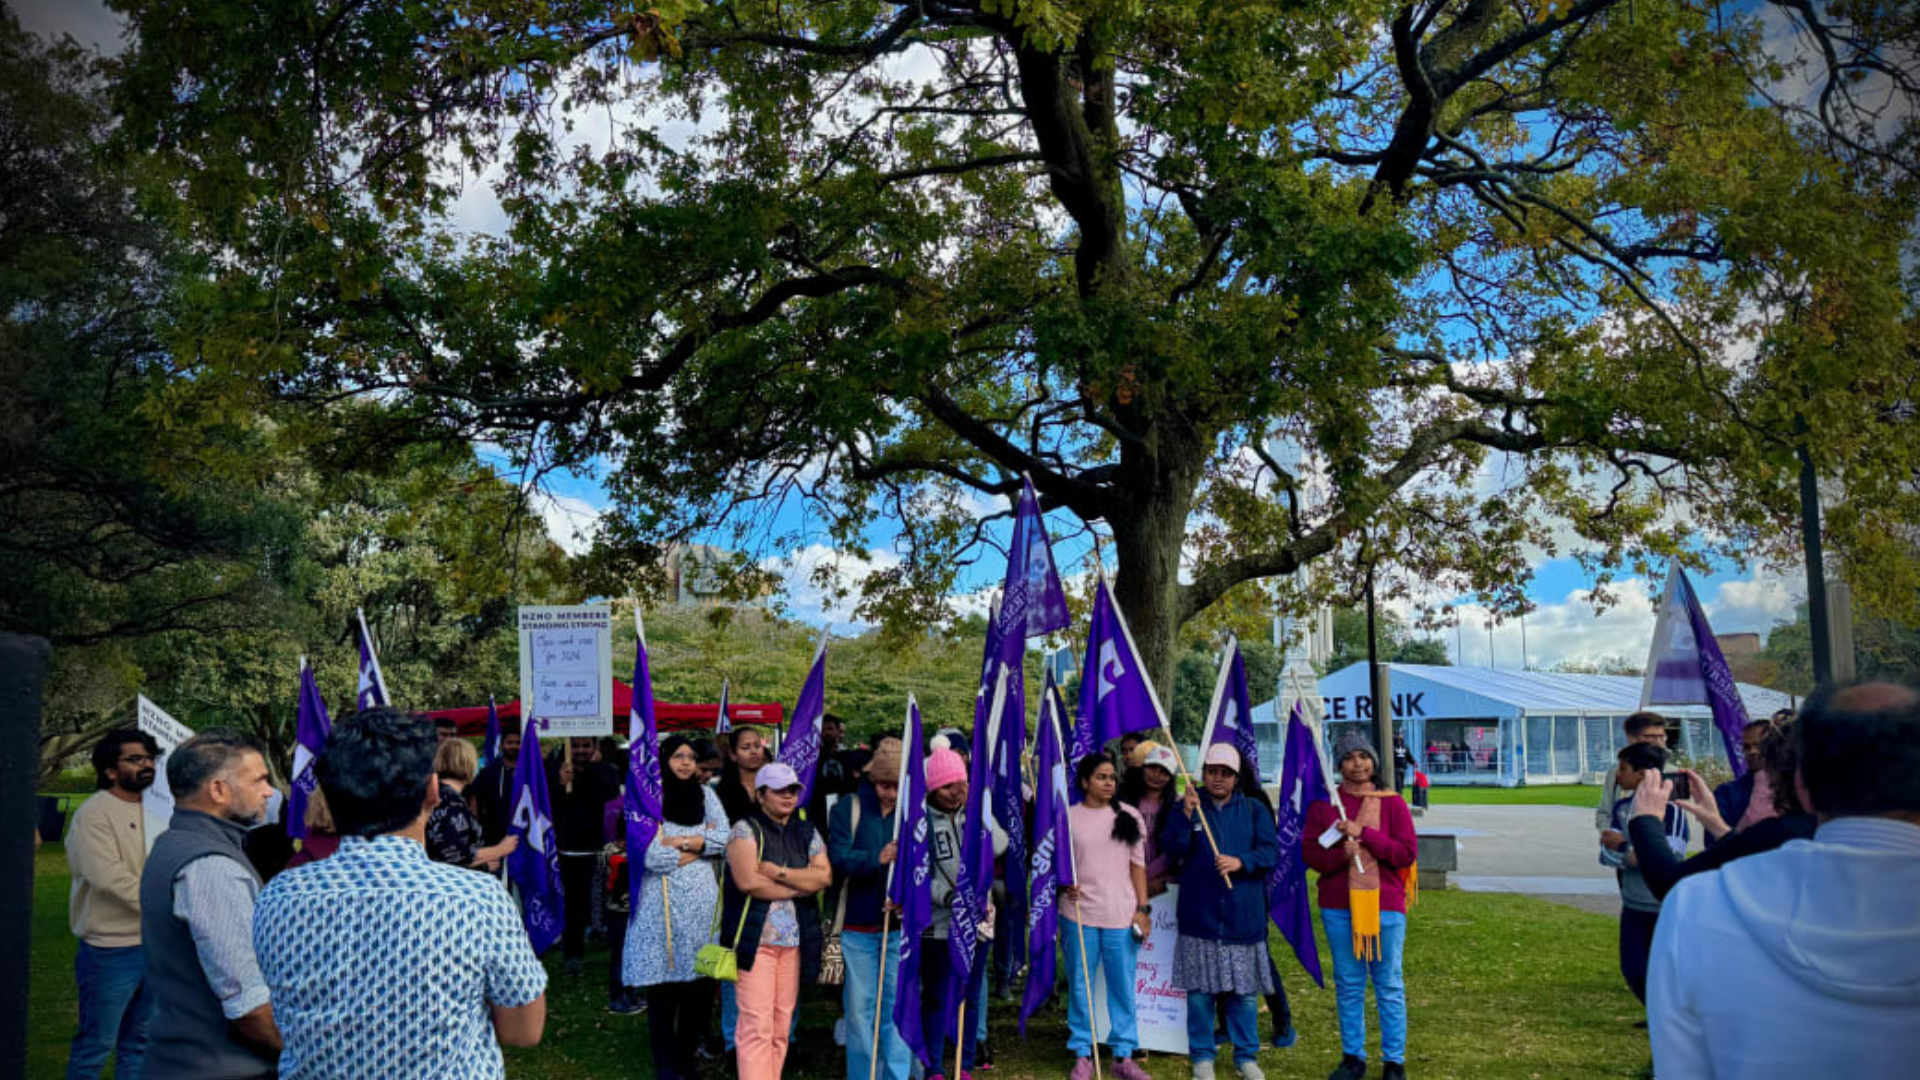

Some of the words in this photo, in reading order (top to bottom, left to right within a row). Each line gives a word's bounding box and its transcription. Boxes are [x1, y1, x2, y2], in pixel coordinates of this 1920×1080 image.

[522, 612, 552, 620] NZNO
[557, 612, 608, 620] MEMBERS
[521, 621, 569, 630] STANDING
[1322, 696, 1348, 720] CE
[1355, 691, 1426, 719] RNK
